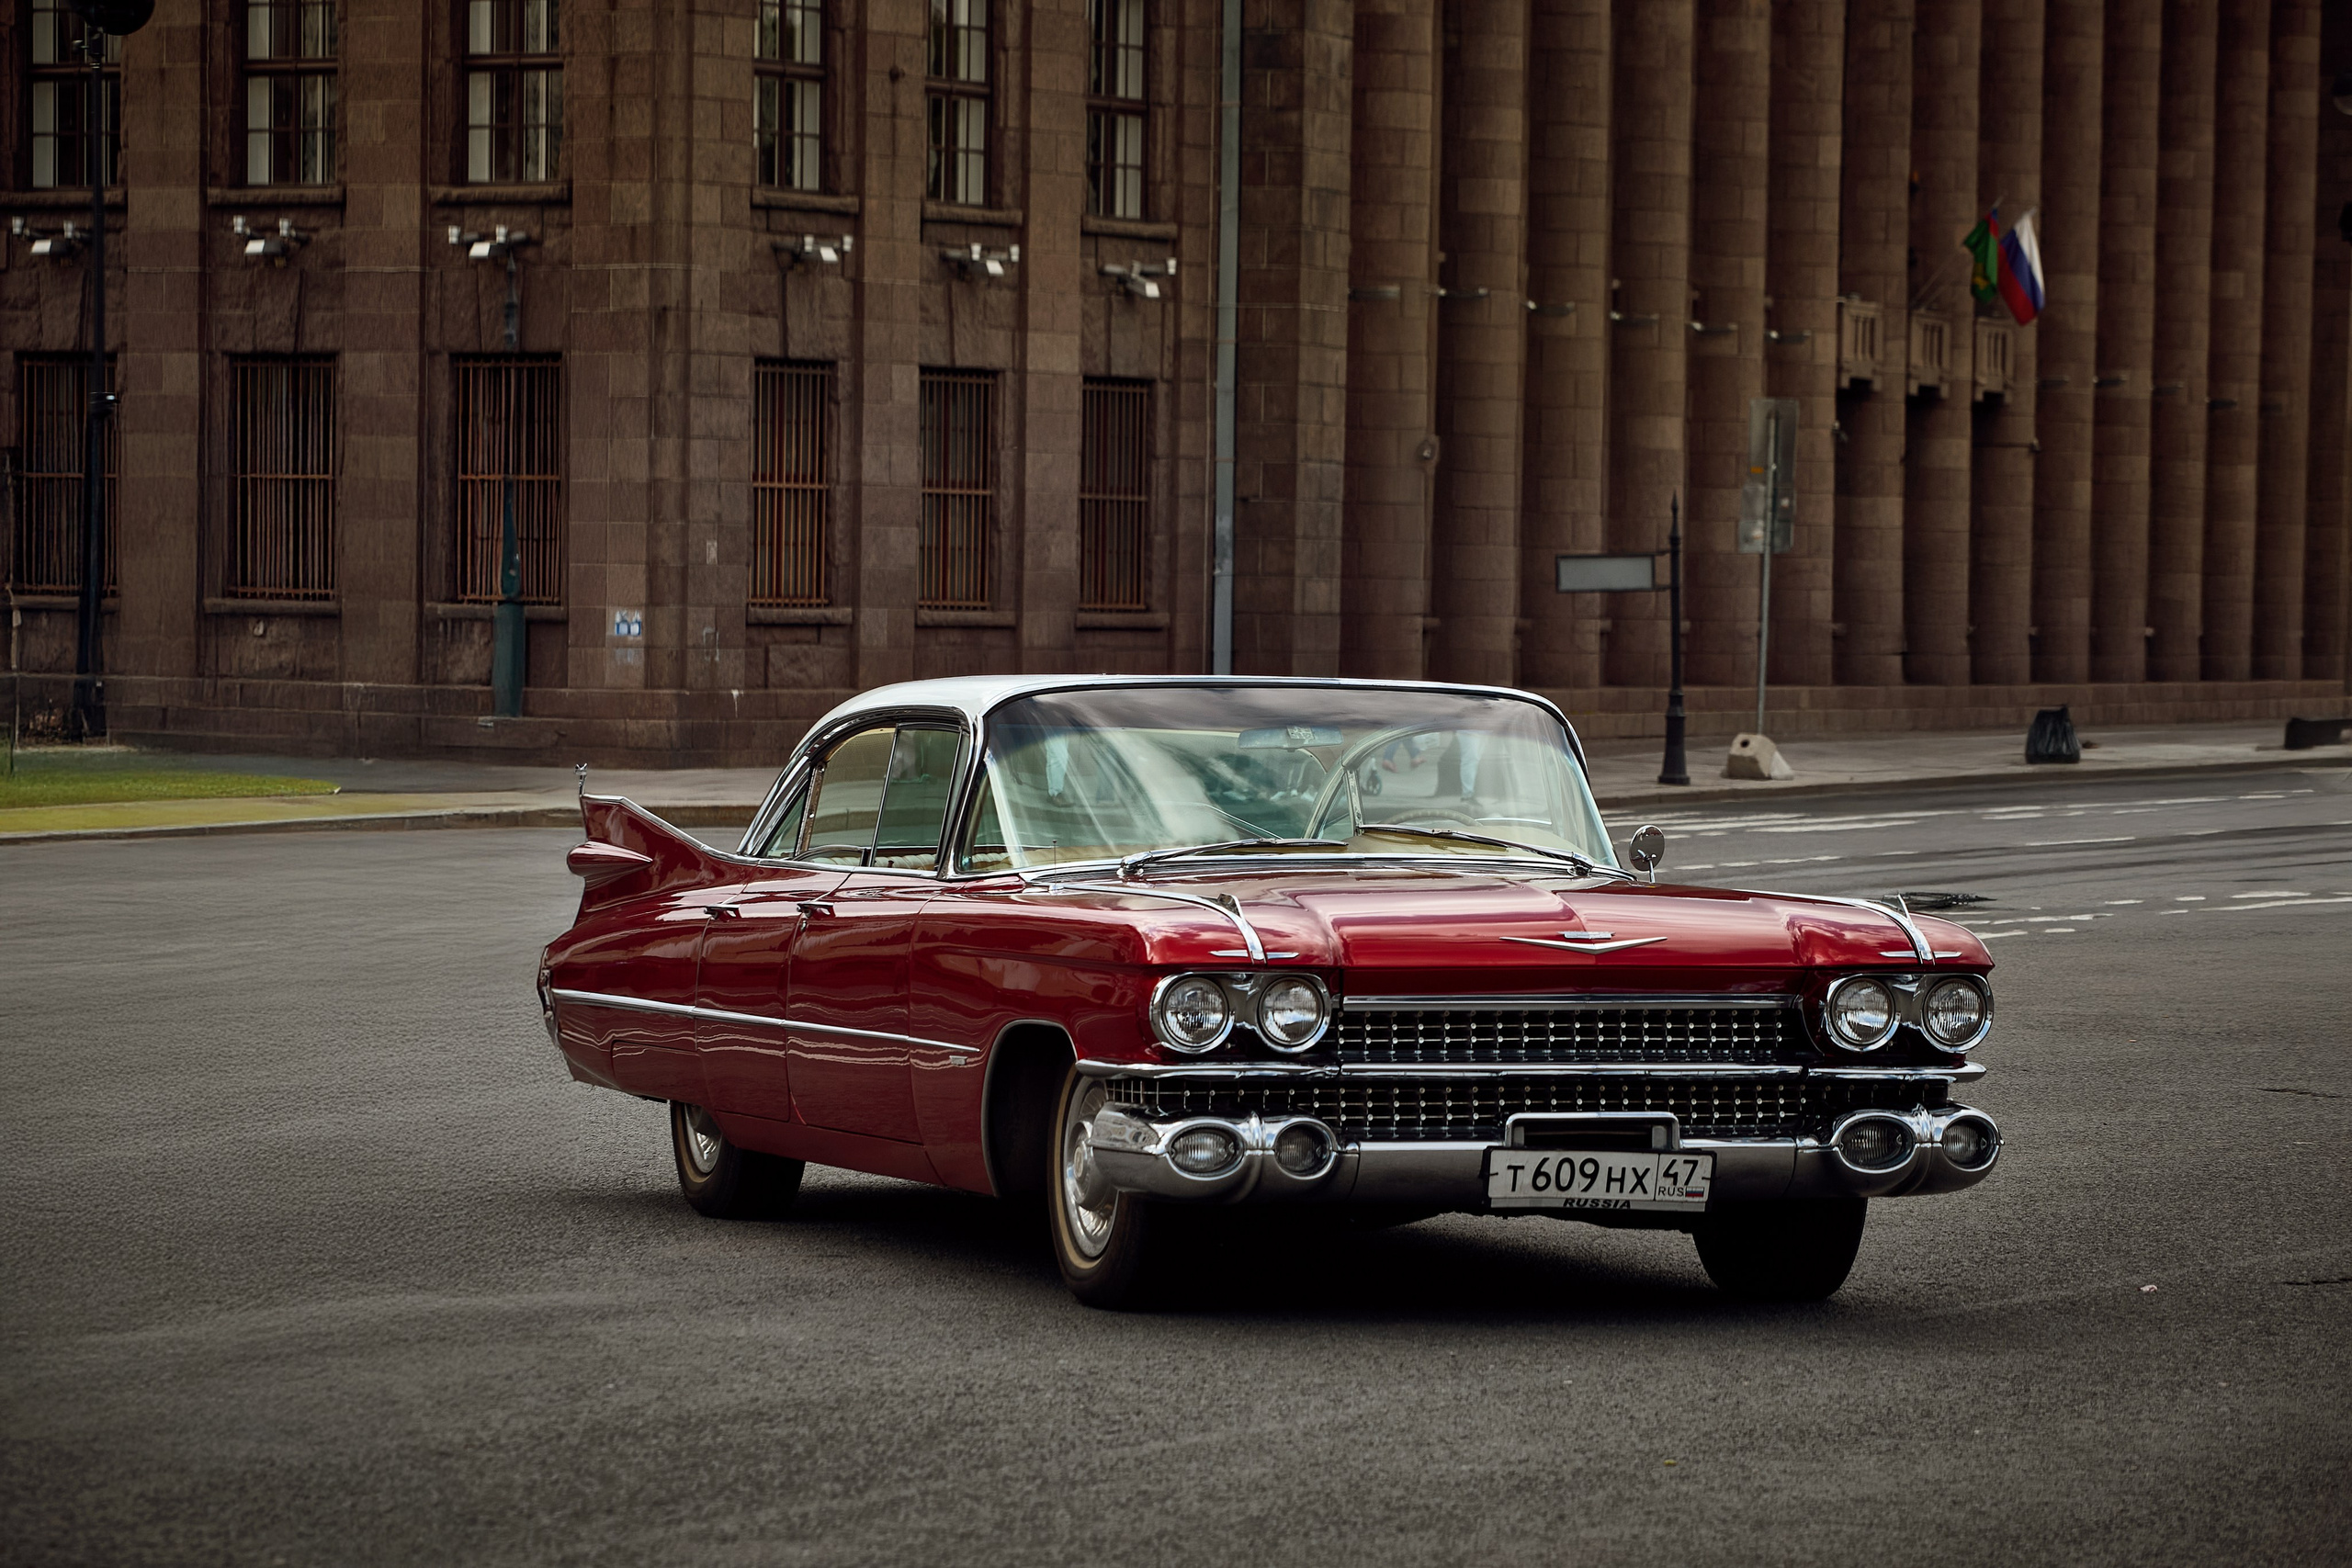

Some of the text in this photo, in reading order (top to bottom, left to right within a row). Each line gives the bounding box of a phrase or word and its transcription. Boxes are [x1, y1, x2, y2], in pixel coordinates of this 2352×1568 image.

[1663, 1158, 1699, 1186] 47
[1657, 1186, 1684, 1197] RUS
[1563, 1197, 1631, 1210] RUSSIA
